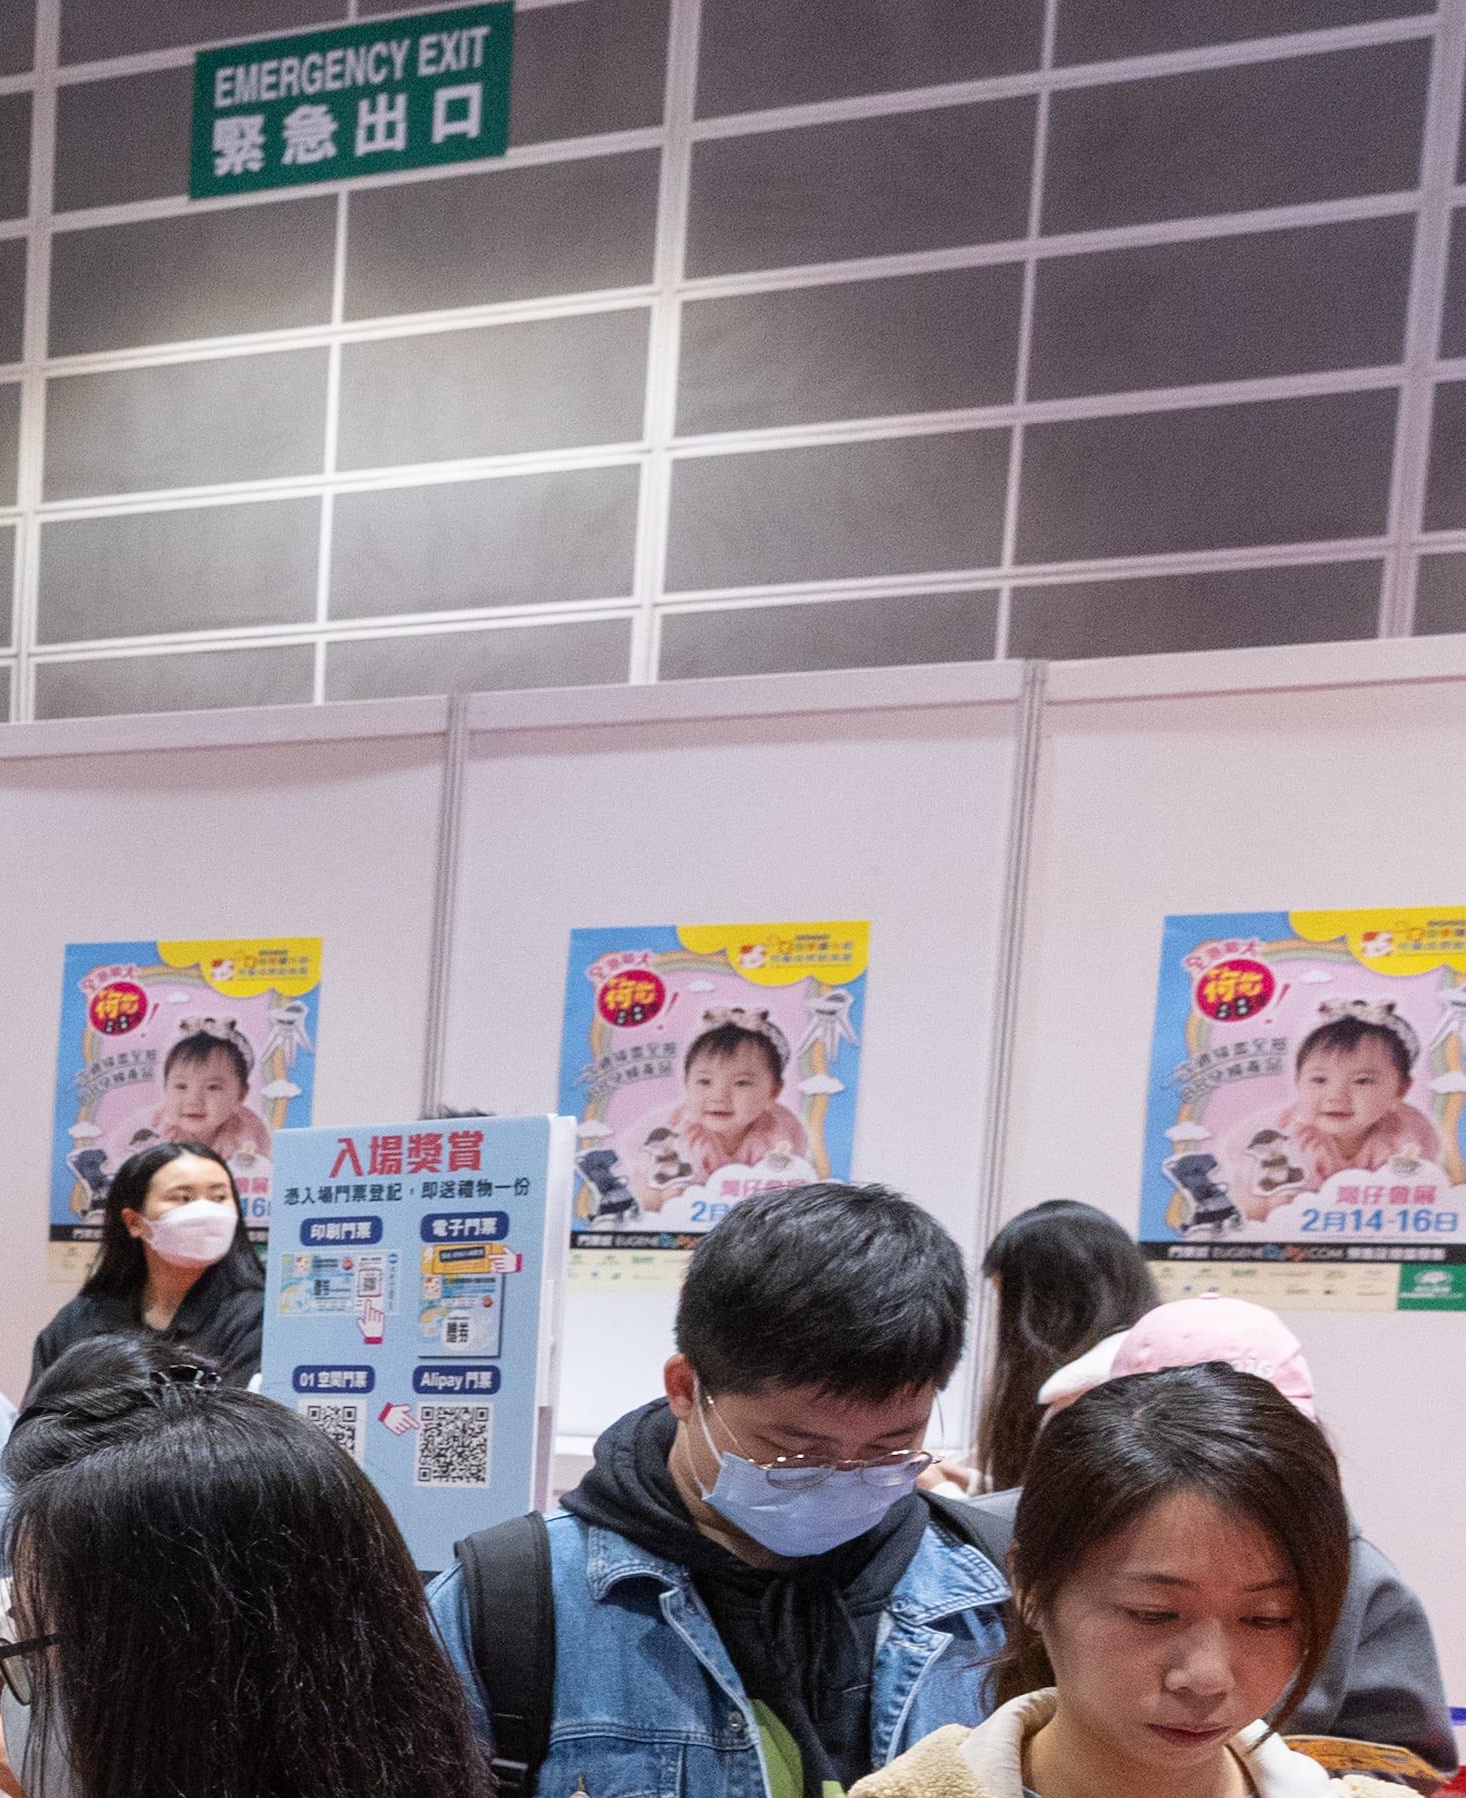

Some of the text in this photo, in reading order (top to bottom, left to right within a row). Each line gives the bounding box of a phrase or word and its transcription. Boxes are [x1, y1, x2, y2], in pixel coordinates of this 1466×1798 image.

[214, 26, 491, 108] EMERGENCY EXIT
[212, 83, 482, 176] 緊急出口
[328, 1130, 485, 1178] 入場獎賞
[310, 1221, 372, 1241] 印刷門票
[431, 1217, 499, 1237] 電子門票
[298, 1371, 368, 1390] 01 空間門票
[420, 1371, 493, 1391] Alipay 門票
